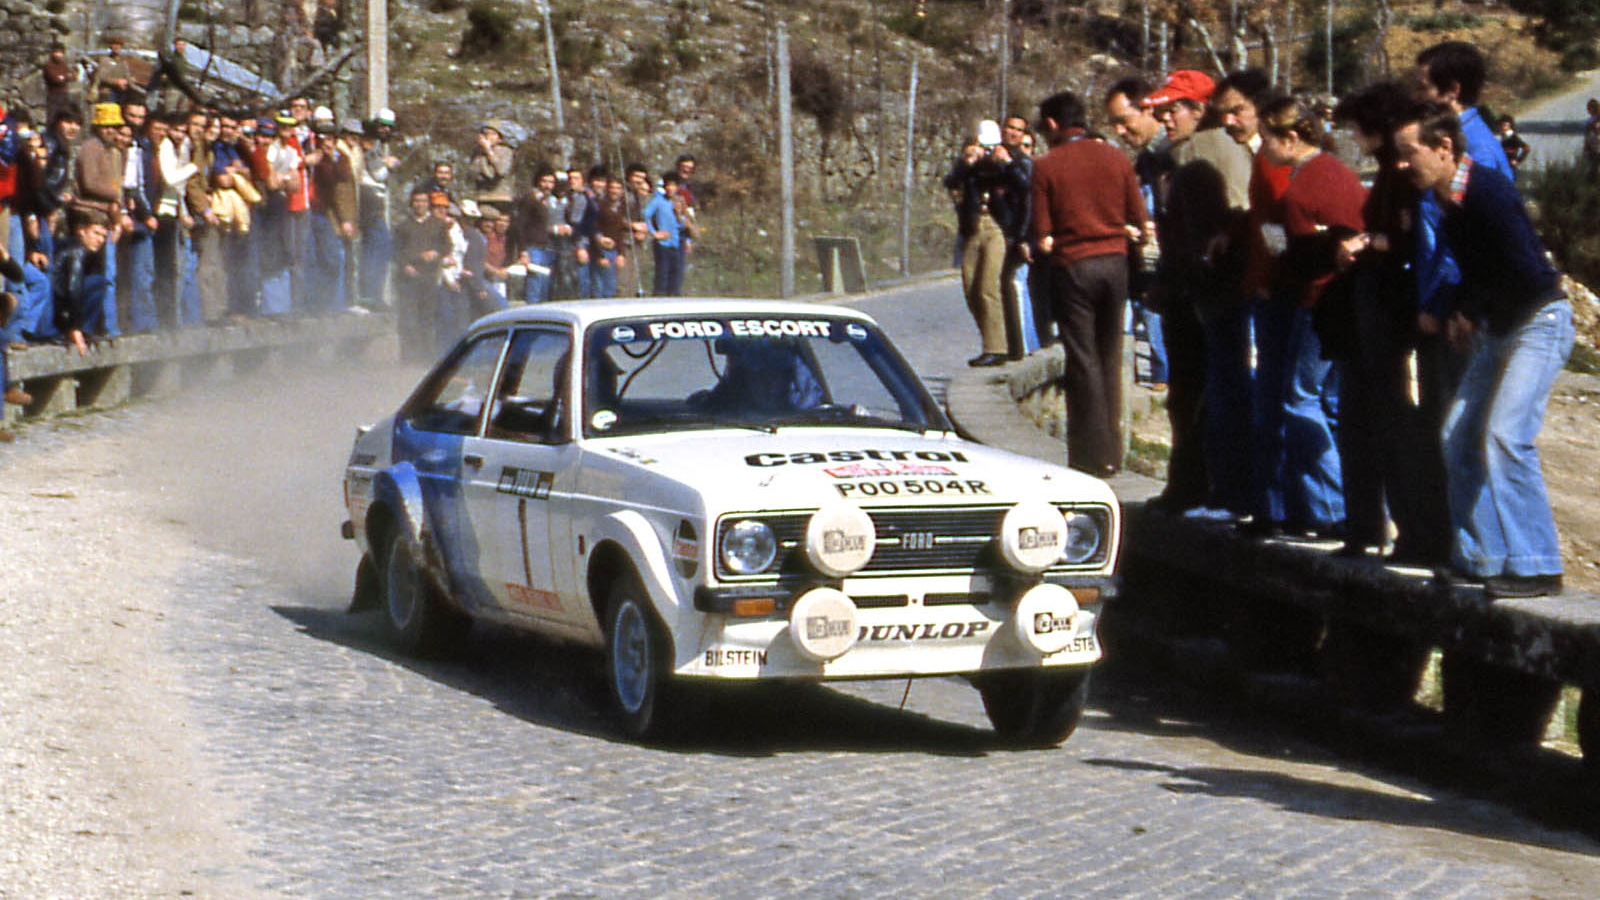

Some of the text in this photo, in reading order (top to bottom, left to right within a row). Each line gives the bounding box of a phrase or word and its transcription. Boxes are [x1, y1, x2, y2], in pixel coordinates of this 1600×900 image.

[649, 321, 723, 340] FORD
[730, 319, 830, 338] ESCORT
[744, 449, 969, 467] Castrol
[903, 532, 933, 549] FORD
[705, 650, 768, 666] BILSTEIN
